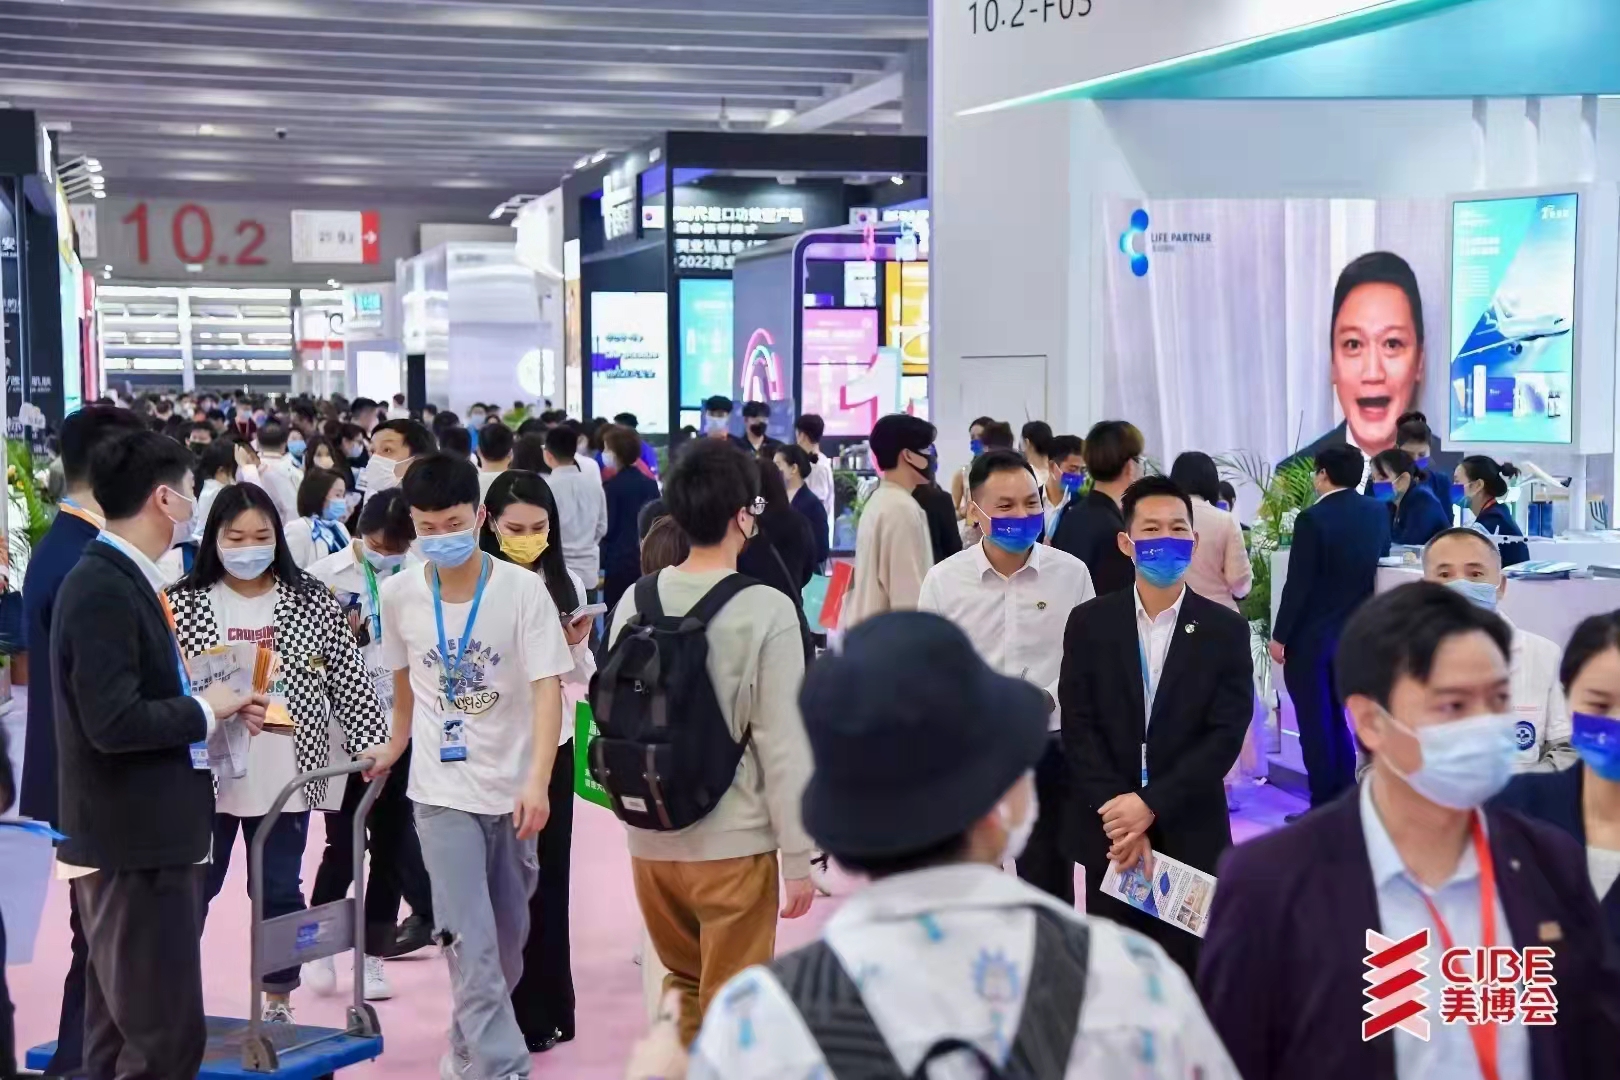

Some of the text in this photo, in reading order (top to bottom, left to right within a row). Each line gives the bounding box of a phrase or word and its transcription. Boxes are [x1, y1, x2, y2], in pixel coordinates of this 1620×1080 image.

[121, 202, 268, 267] 10.2
[1150, 232, 1211, 242] LIFE PARTNER
[422, 637, 501, 668] SUEMAN
